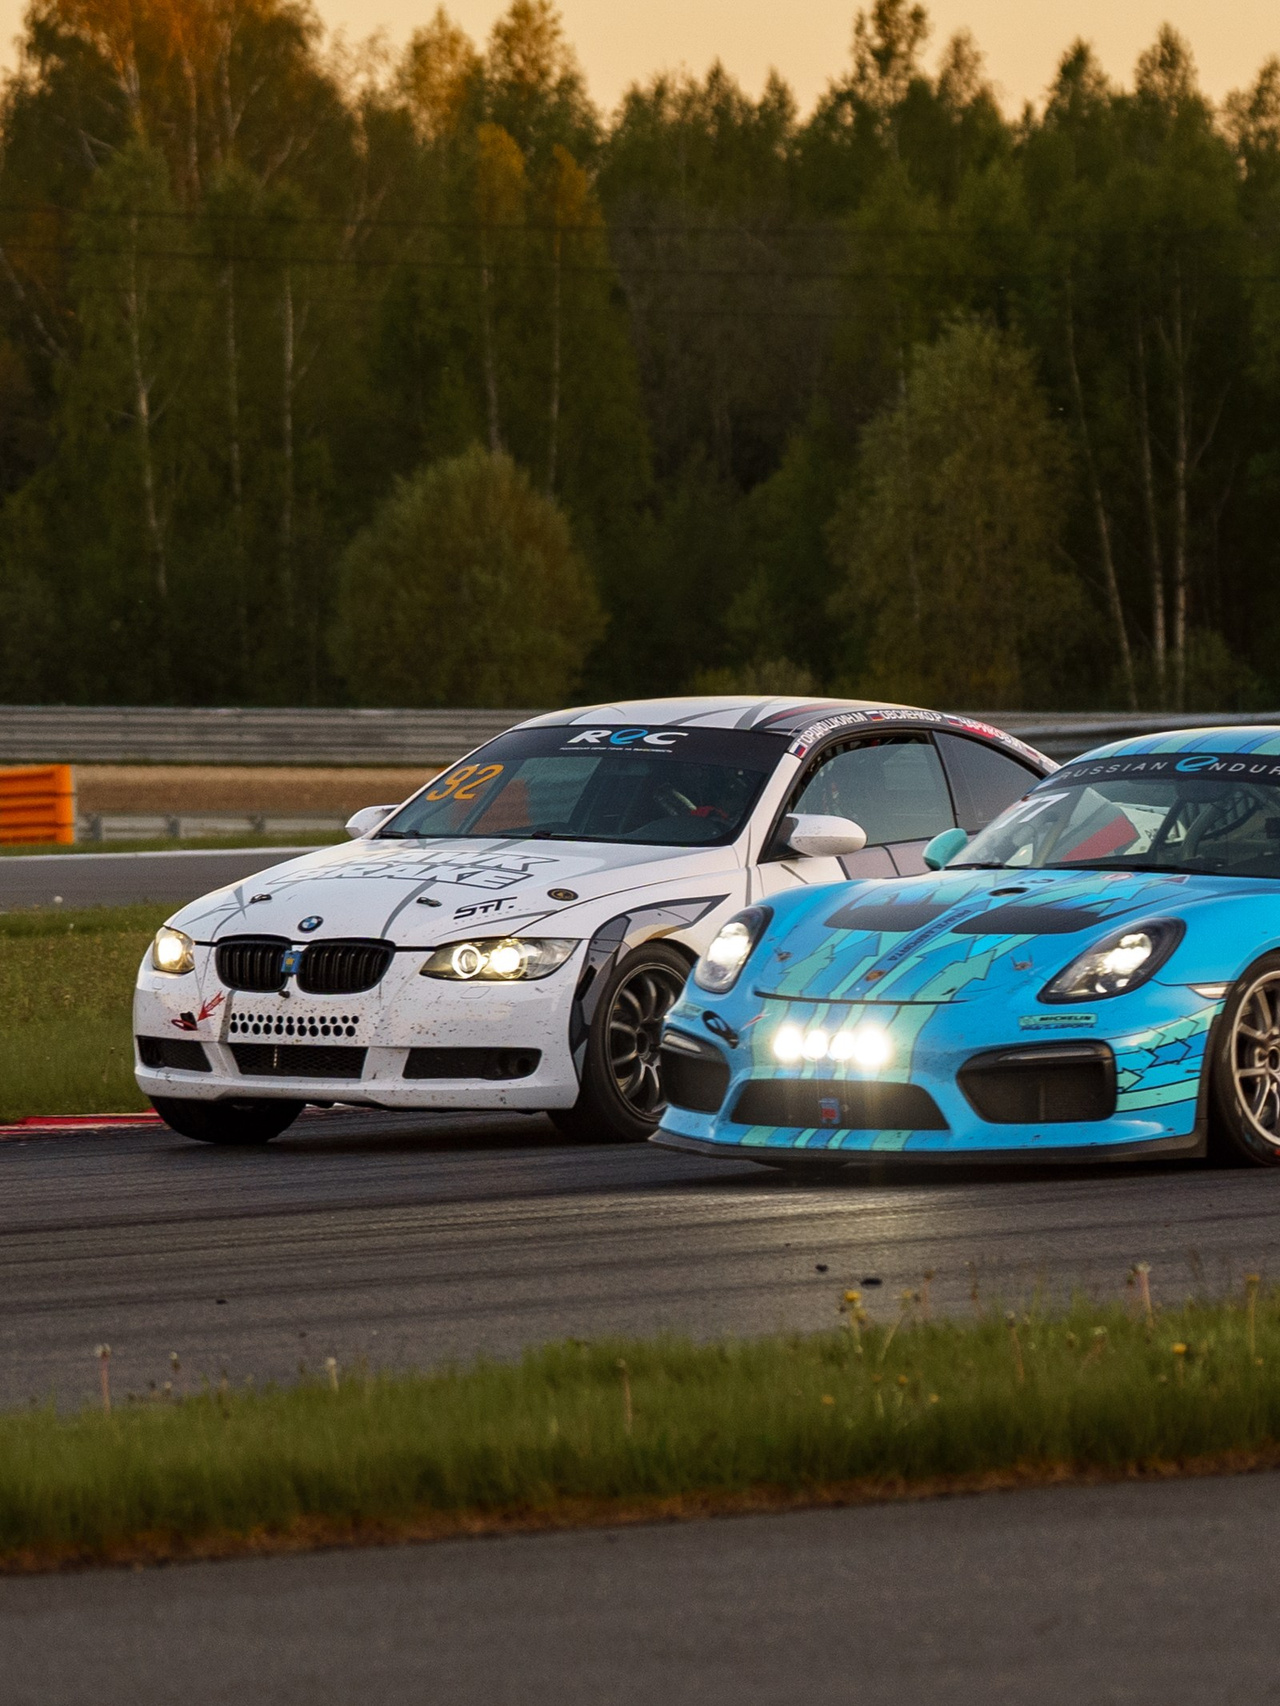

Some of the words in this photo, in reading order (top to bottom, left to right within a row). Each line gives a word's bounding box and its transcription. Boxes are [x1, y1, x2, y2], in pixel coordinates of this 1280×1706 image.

[426, 764, 504, 802] 92
[1060, 762, 1168, 780] RUSSIAN
[265, 862, 534, 890] BRAKE
